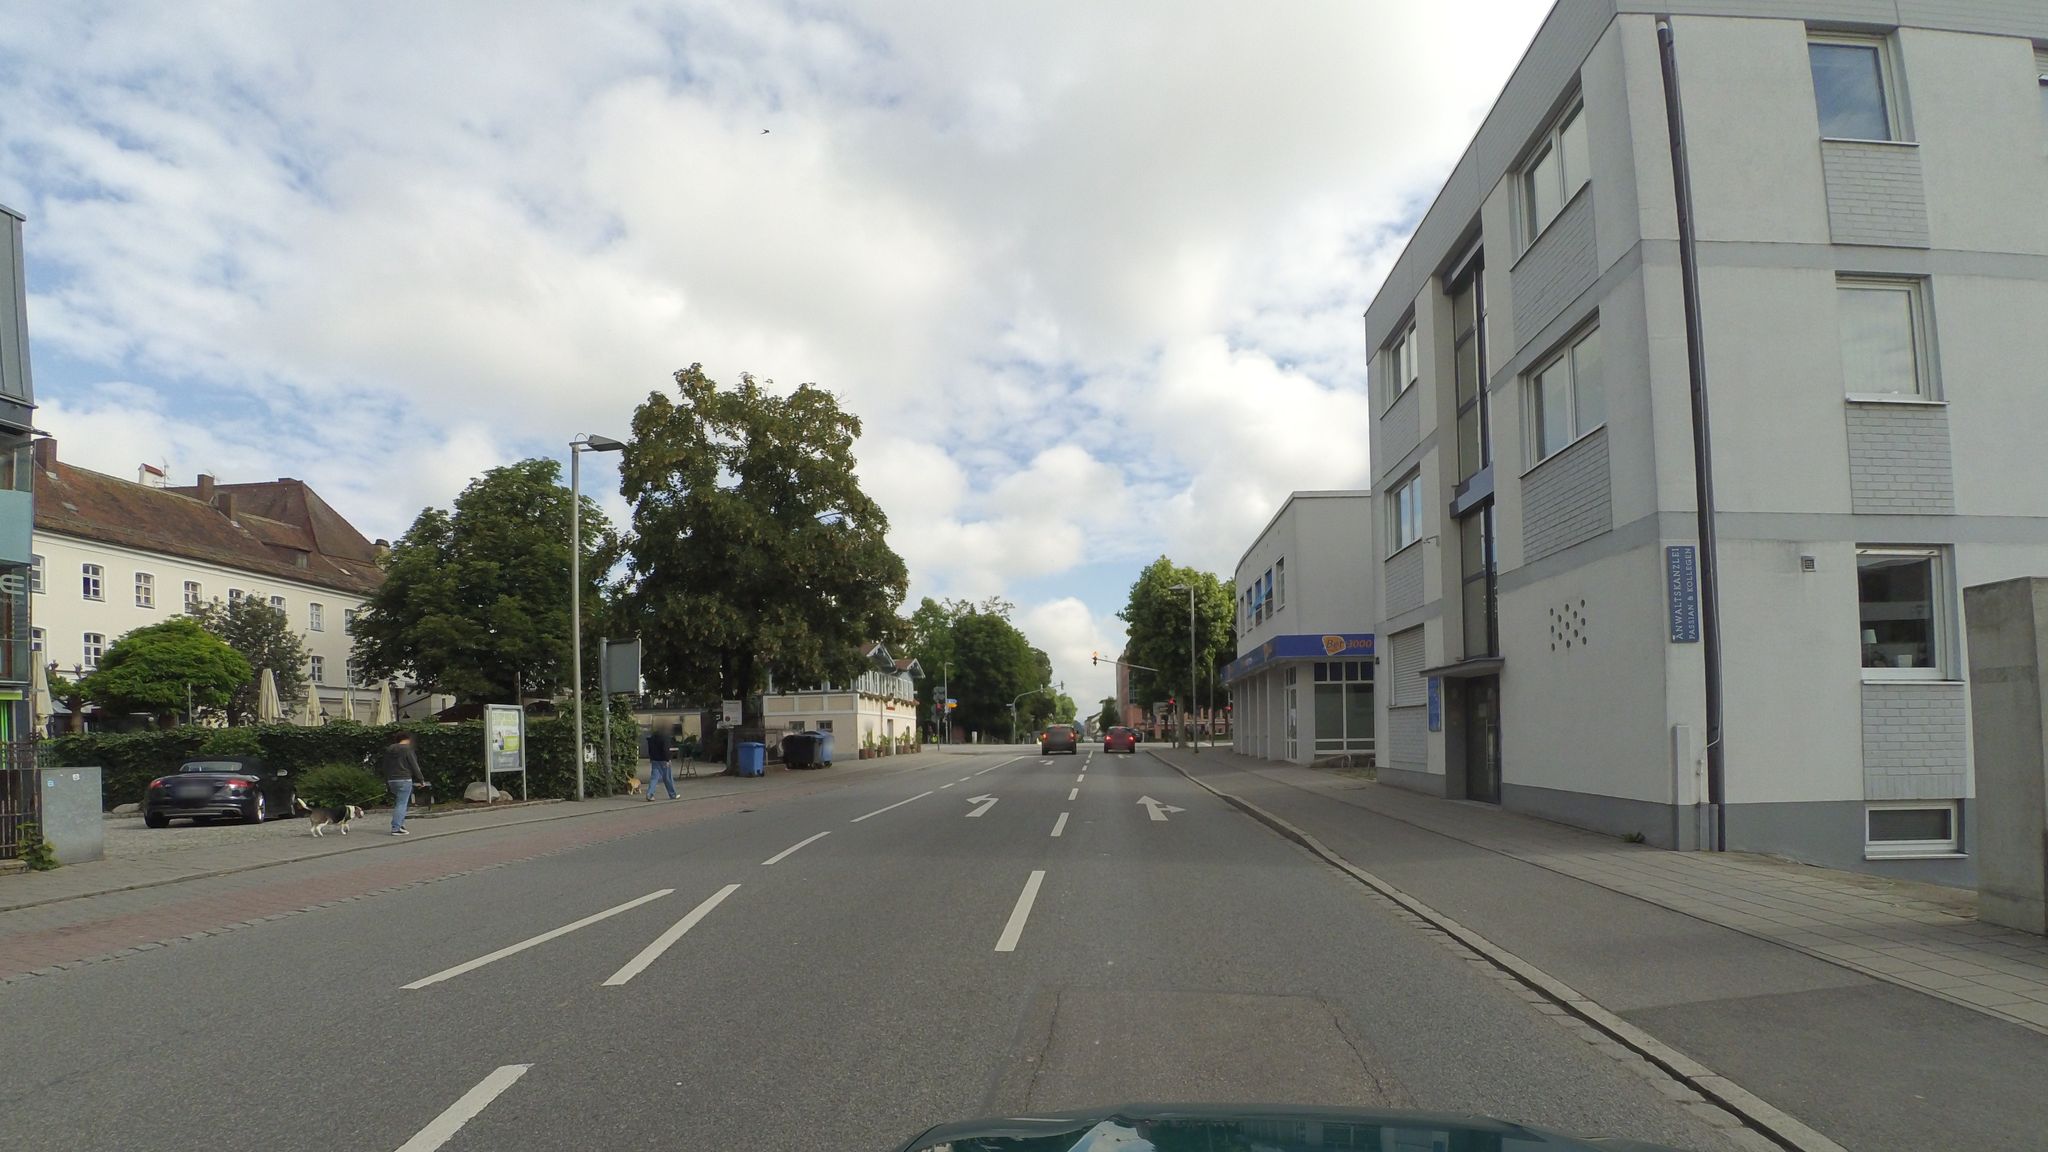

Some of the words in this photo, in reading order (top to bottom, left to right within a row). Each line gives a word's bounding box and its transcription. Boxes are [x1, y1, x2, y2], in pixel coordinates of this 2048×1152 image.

[1685, 548, 1694, 593] KOLLEGEN
[1671, 548, 1683, 640] ANWALTSKANZLEI
[1688, 604, 1696, 640] PASSIAN
